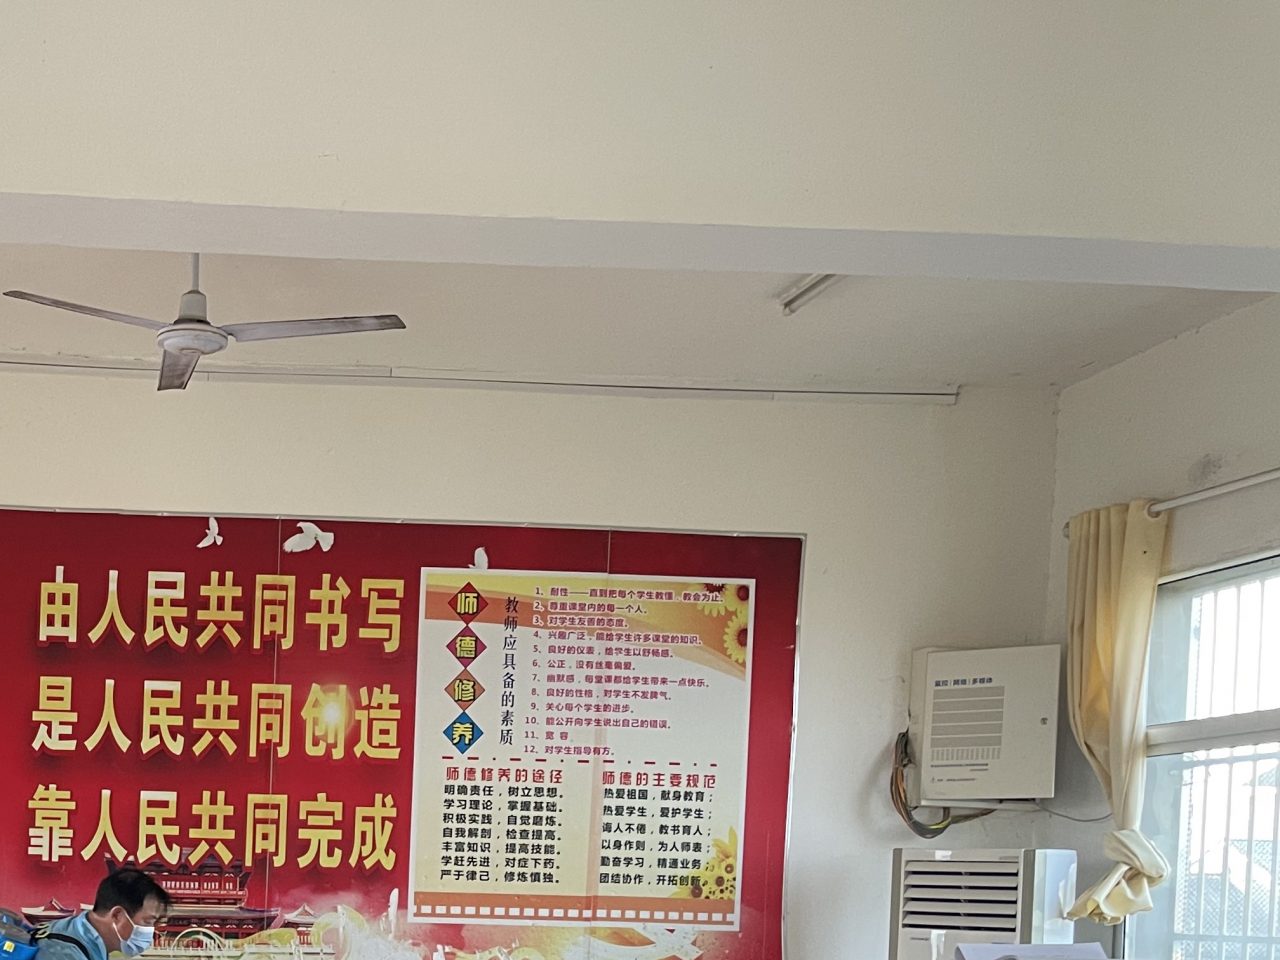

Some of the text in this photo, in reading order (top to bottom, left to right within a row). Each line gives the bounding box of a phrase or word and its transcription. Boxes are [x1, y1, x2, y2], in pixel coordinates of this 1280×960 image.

[39, 566, 404, 652] 由人民共同书写
[452, 592, 478, 745] 师德修养
[499, 596, 519, 746] 教师应具备的素质
[32, 676, 401, 759] 是人民共同创造
[446, 766, 563, 783] 师德修养的途径
[602, 771, 716, 788] 师德的主要规范
[28, 784, 397, 870] 靠人民共同完成
